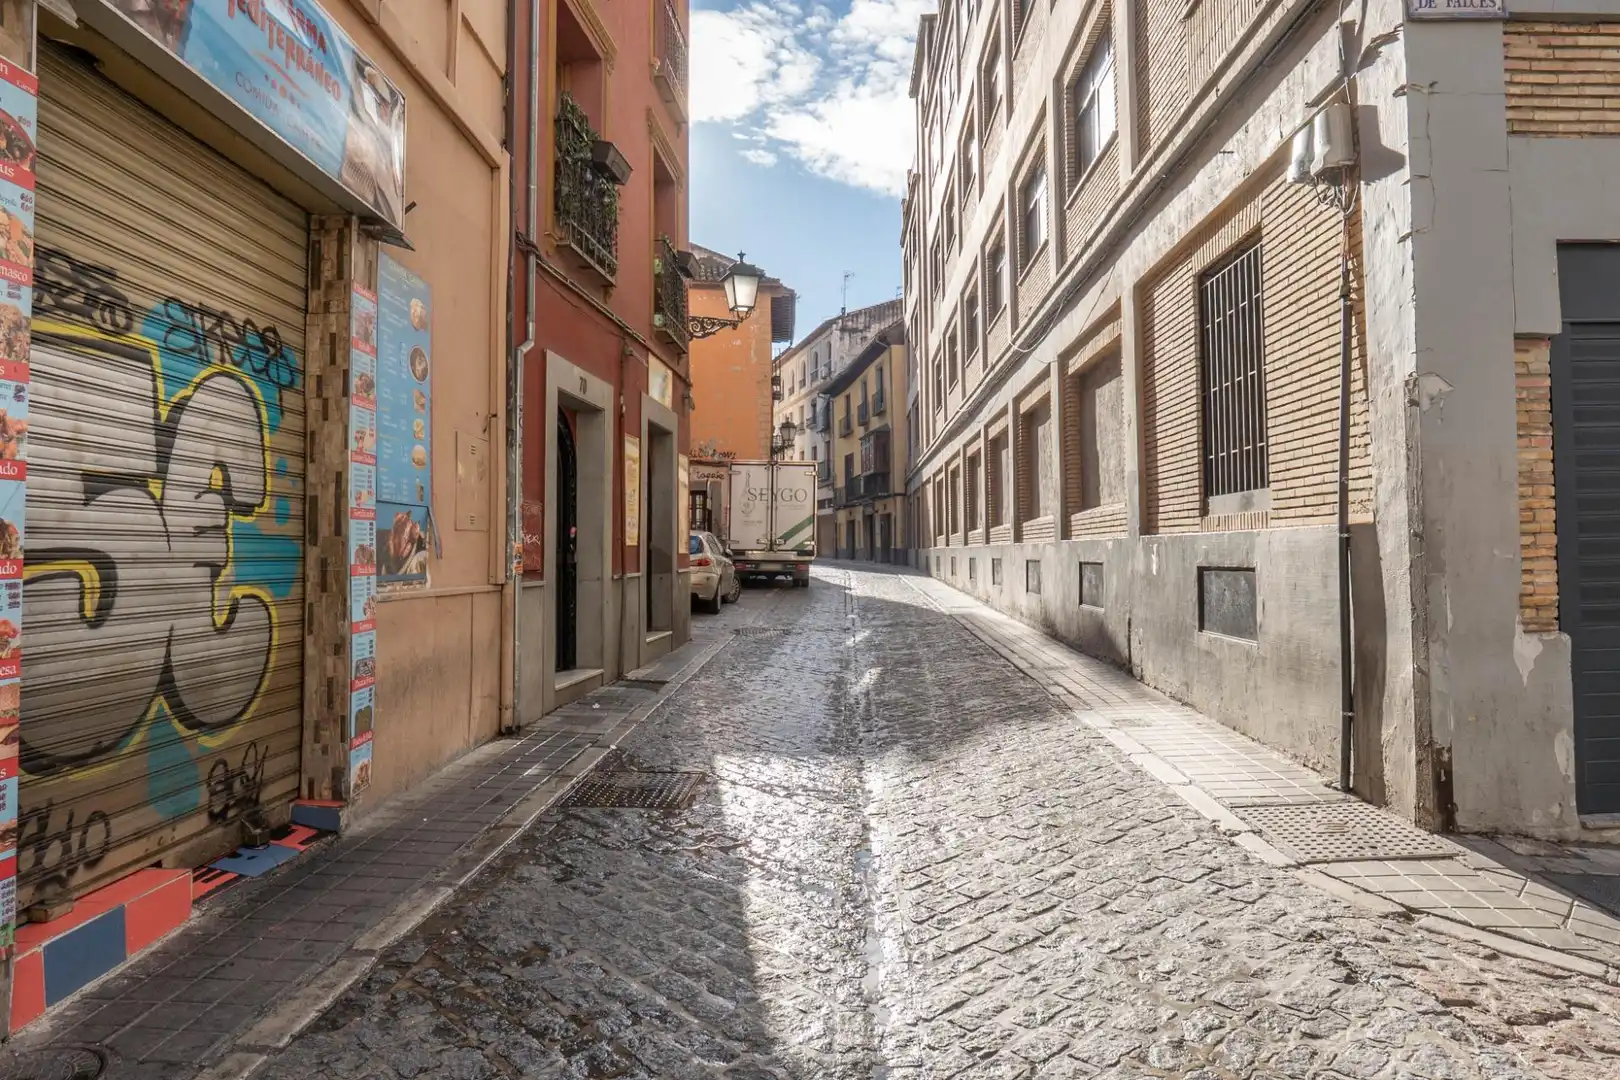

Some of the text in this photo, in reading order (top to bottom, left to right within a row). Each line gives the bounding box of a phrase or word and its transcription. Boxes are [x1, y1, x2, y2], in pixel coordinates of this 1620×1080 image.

[1419, 0, 1497, 9] DE FALCES
[747, 487, 808, 503] SEYGO
